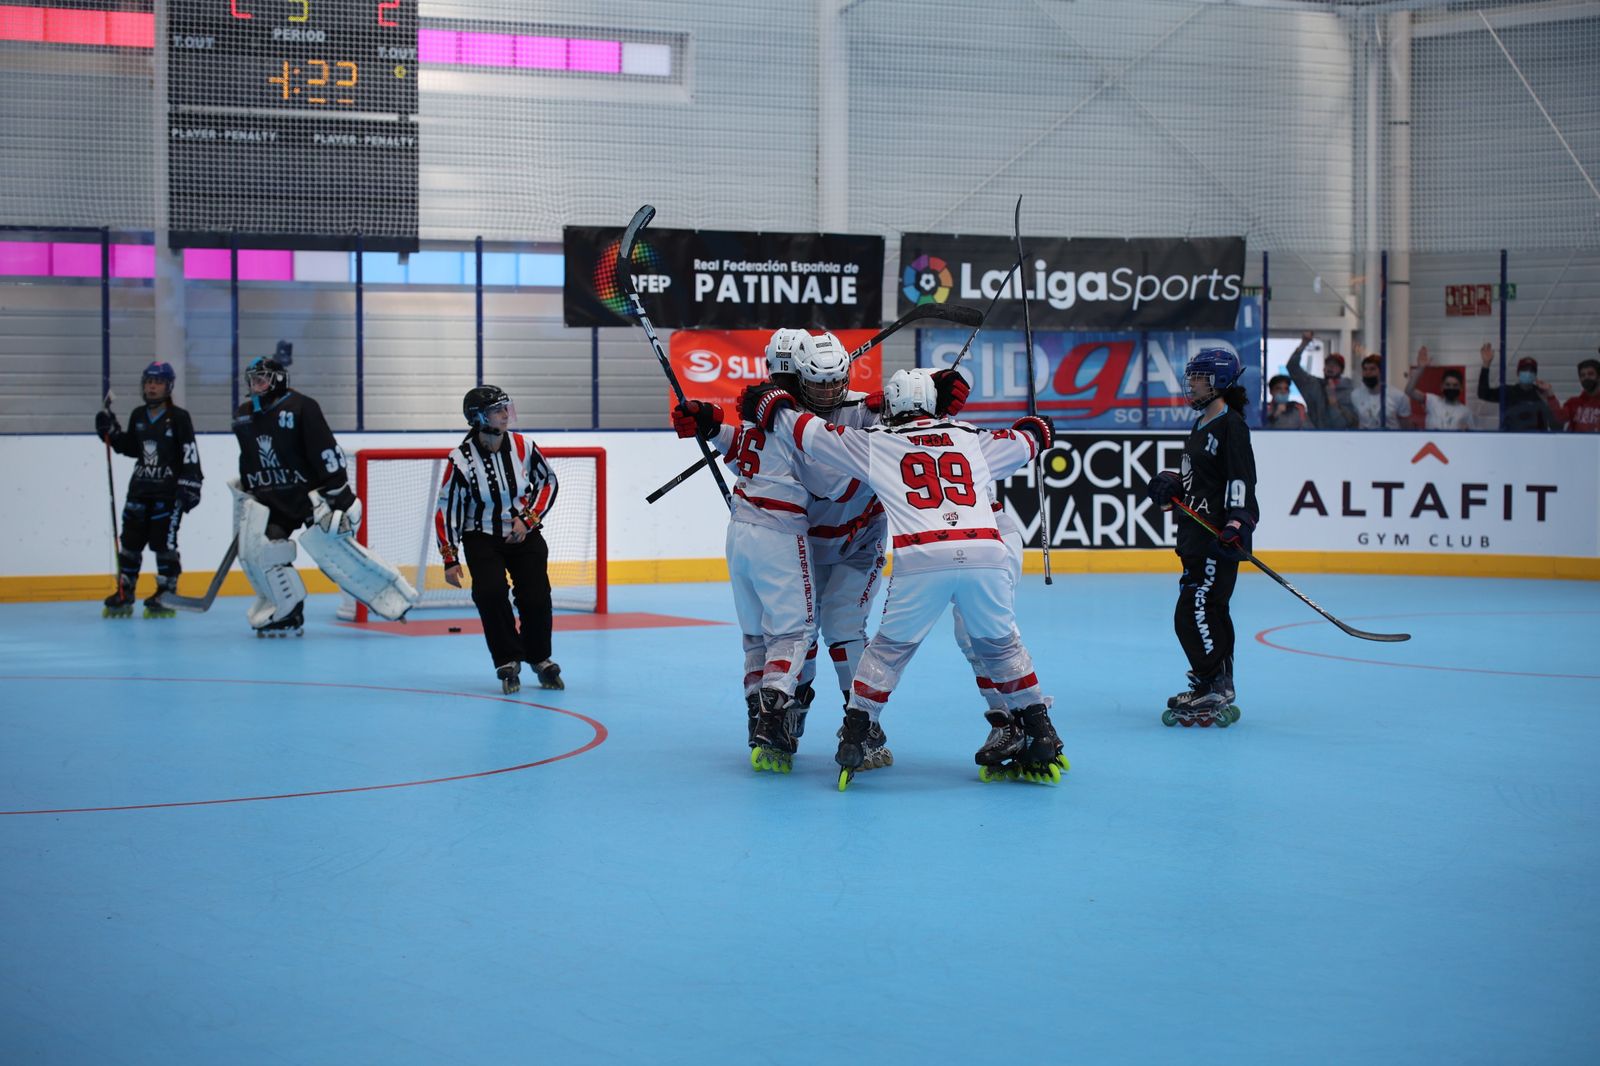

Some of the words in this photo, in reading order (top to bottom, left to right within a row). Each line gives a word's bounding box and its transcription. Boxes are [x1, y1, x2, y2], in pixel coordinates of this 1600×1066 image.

[273, 28, 326, 42] PERIOD
[268, 60, 358, 103] 4:22
[171, 128, 216, 138] PLAYER
[224, 130, 277, 141] PENALTY
[313, 133, 357, 145] PLAYER
[364, 136, 414, 147] PENALTY
[694, 259, 719, 271] Real
[723, 259, 788, 273] Federación
[791, 260, 841, 274] Española
[843, 262, 860, 273] de
[694, 274, 858, 305] PATINAJE
[780, 360, 789, 371] 16
[1114, 408, 1200, 423] SOFTWA
[900, 451, 977, 510] 99
[1289, 480, 1558, 522] ALTAFIT
[1357, 532, 1410, 546] GYM
[1428, 533, 1491, 548] CLUB
